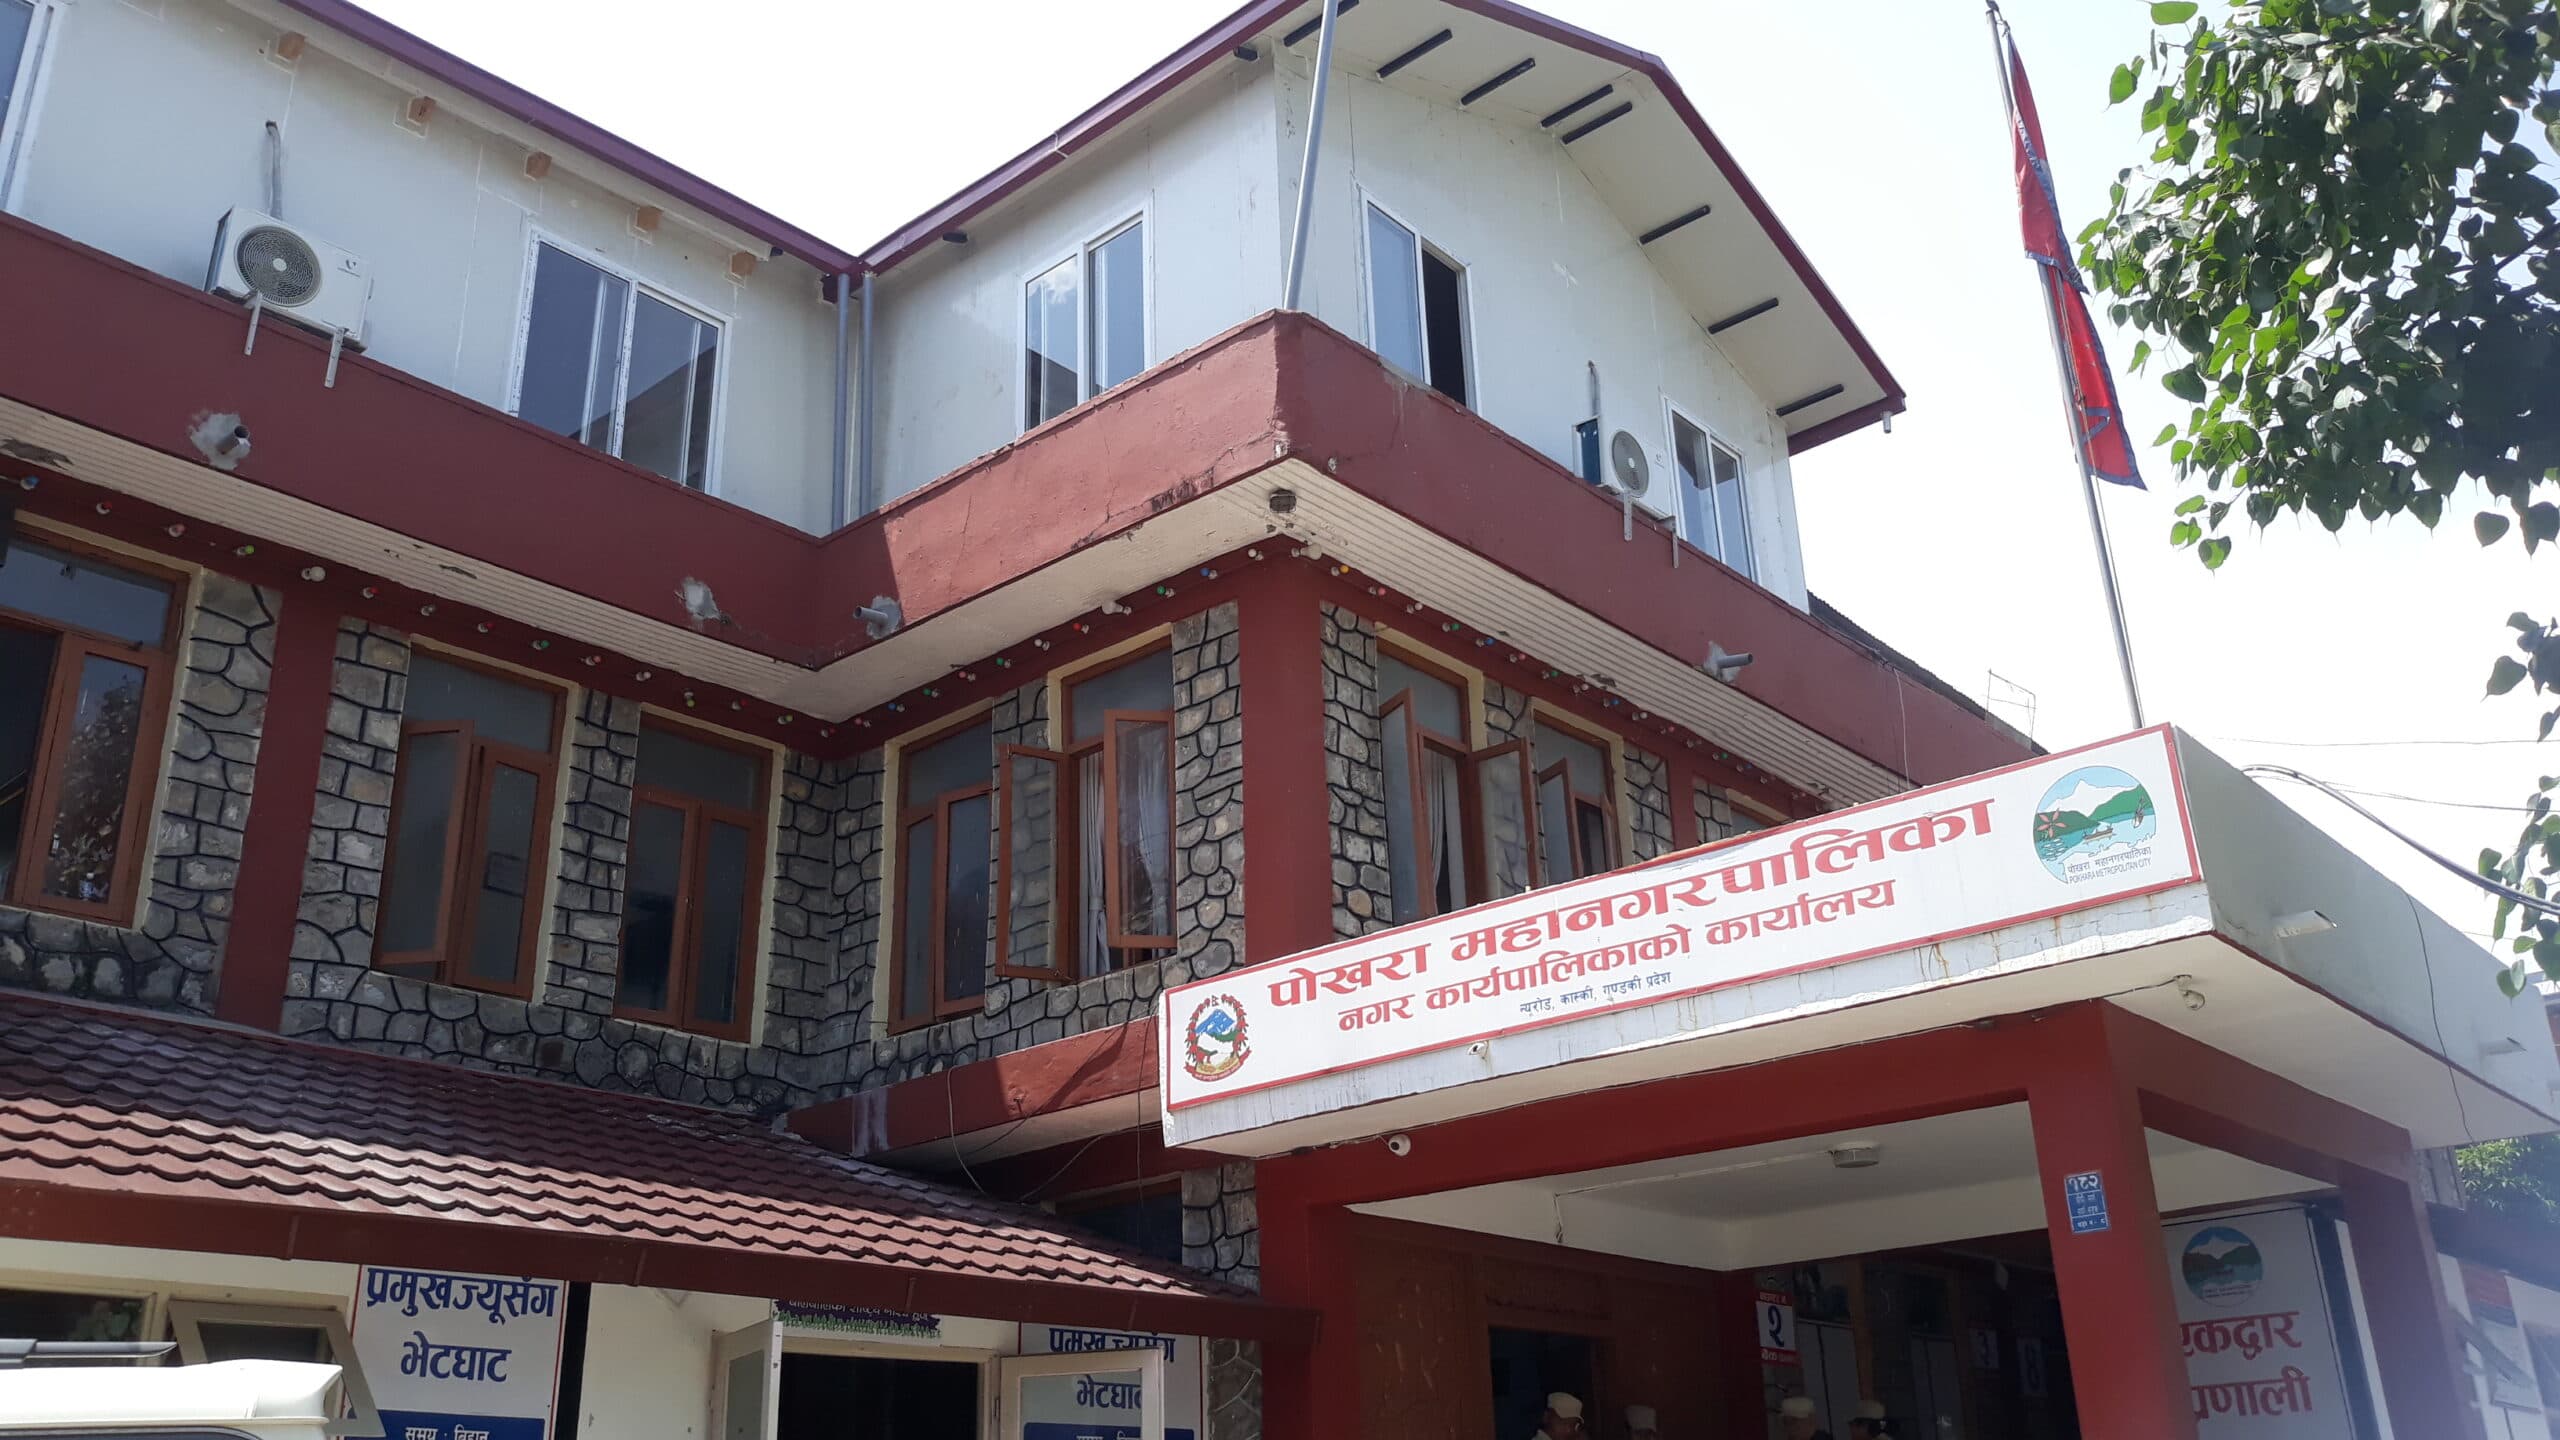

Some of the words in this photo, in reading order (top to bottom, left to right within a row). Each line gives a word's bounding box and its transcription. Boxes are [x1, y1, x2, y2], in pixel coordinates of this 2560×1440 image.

[2068, 871, 2097, 885] POKHARA
[2096, 862, 2138, 879] METROPOLITAN
[2138, 857, 2152, 869] CITY
[2094, 846, 2152, 867] महानगरपालिका
[1268, 942, 1431, 1008] पोखरा
[1451, 799, 1995, 962] महानगरपालिका
[1339, 995, 1413, 1032] नगर
[1426, 923, 1691, 1009] कार्यपालिकाको
[1706, 879, 1896, 946] कार्यालय
[1646, 971, 1672, 987] प्रदेश
[1767, 1305, 1785, 1348] २
[401, 1331, 512, 1383] भेटघाट
